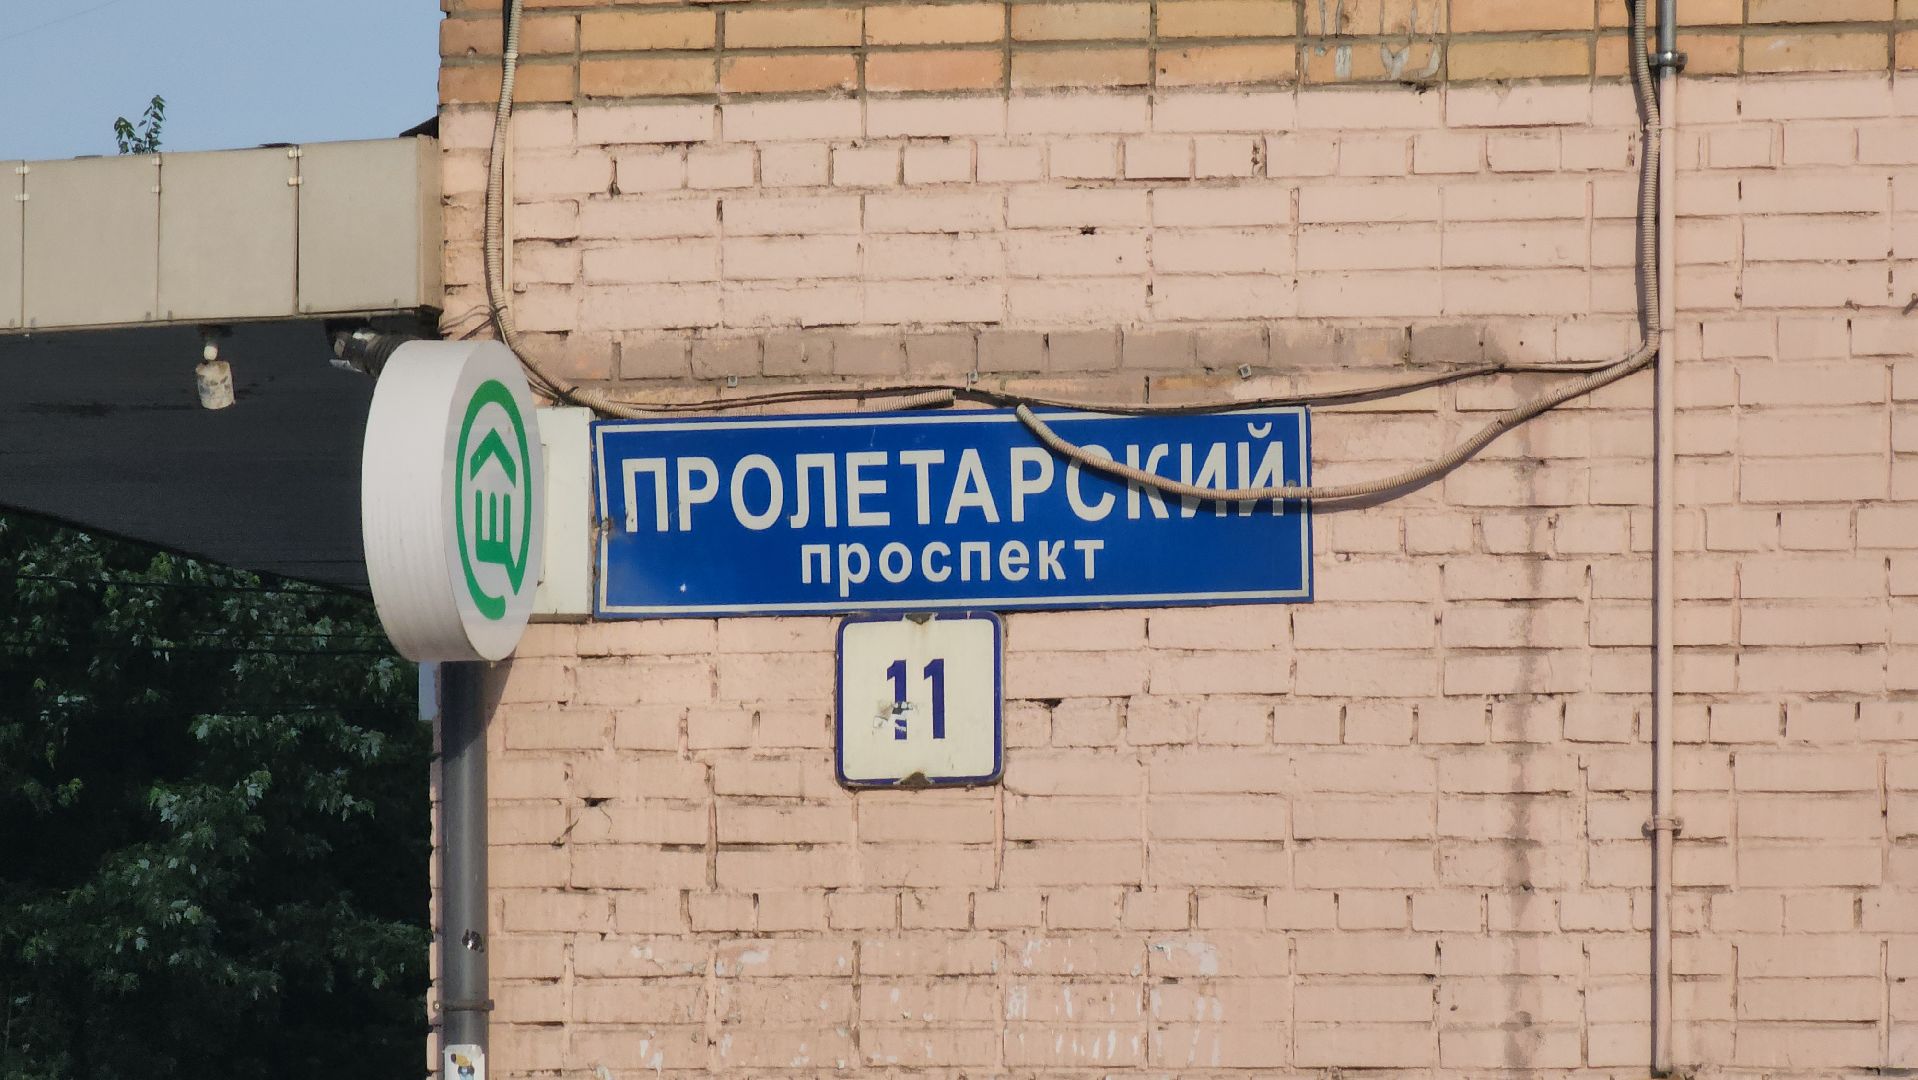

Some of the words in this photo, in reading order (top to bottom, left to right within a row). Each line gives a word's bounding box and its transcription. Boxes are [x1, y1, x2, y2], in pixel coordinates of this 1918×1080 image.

[621, 422, 1285, 533] ПРОЛЕТАРСКИЙ
[801, 540, 1105, 598] проспект
[886, 658, 946, 741] 11
